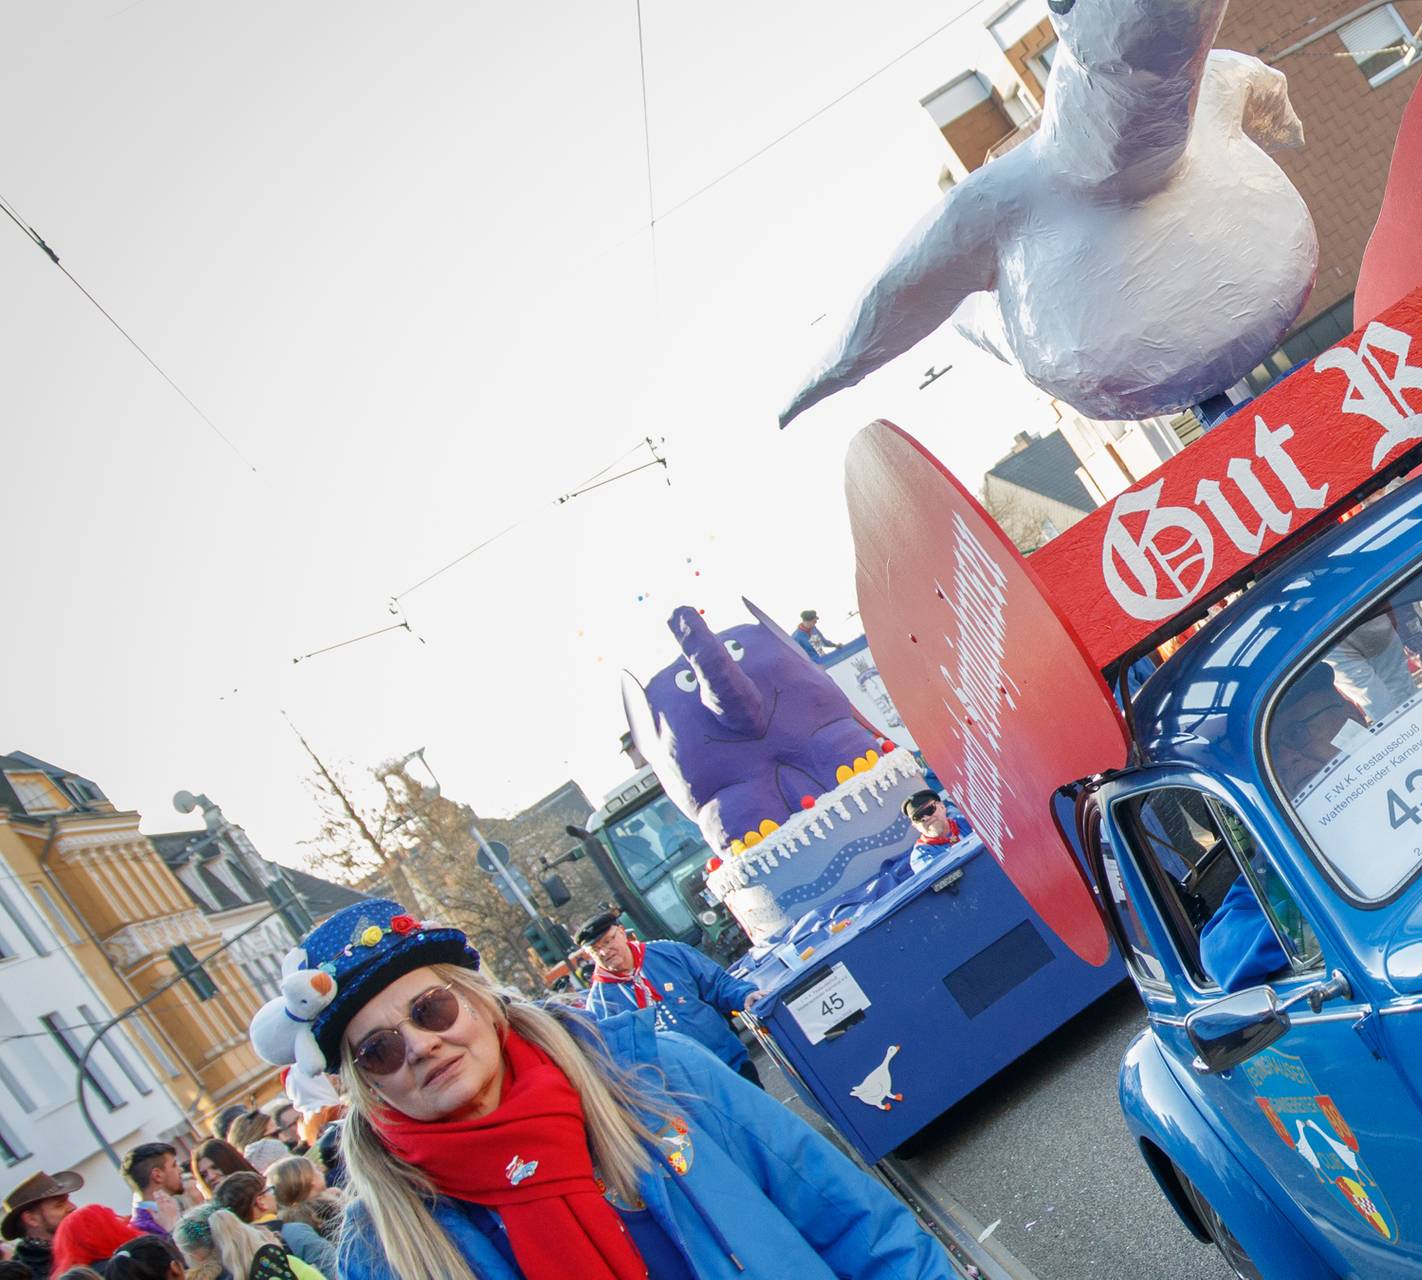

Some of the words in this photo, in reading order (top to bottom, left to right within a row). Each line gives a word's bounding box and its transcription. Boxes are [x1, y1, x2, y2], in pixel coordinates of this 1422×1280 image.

[1102, 415, 1329, 621] Gut
[1319, 765, 1391, 826] Wattenscheider
[1324, 774, 1357, 803] F.W.K.
[1356, 723, 1420, 775] Festausschuß
[821, 992, 844, 1016] 45
